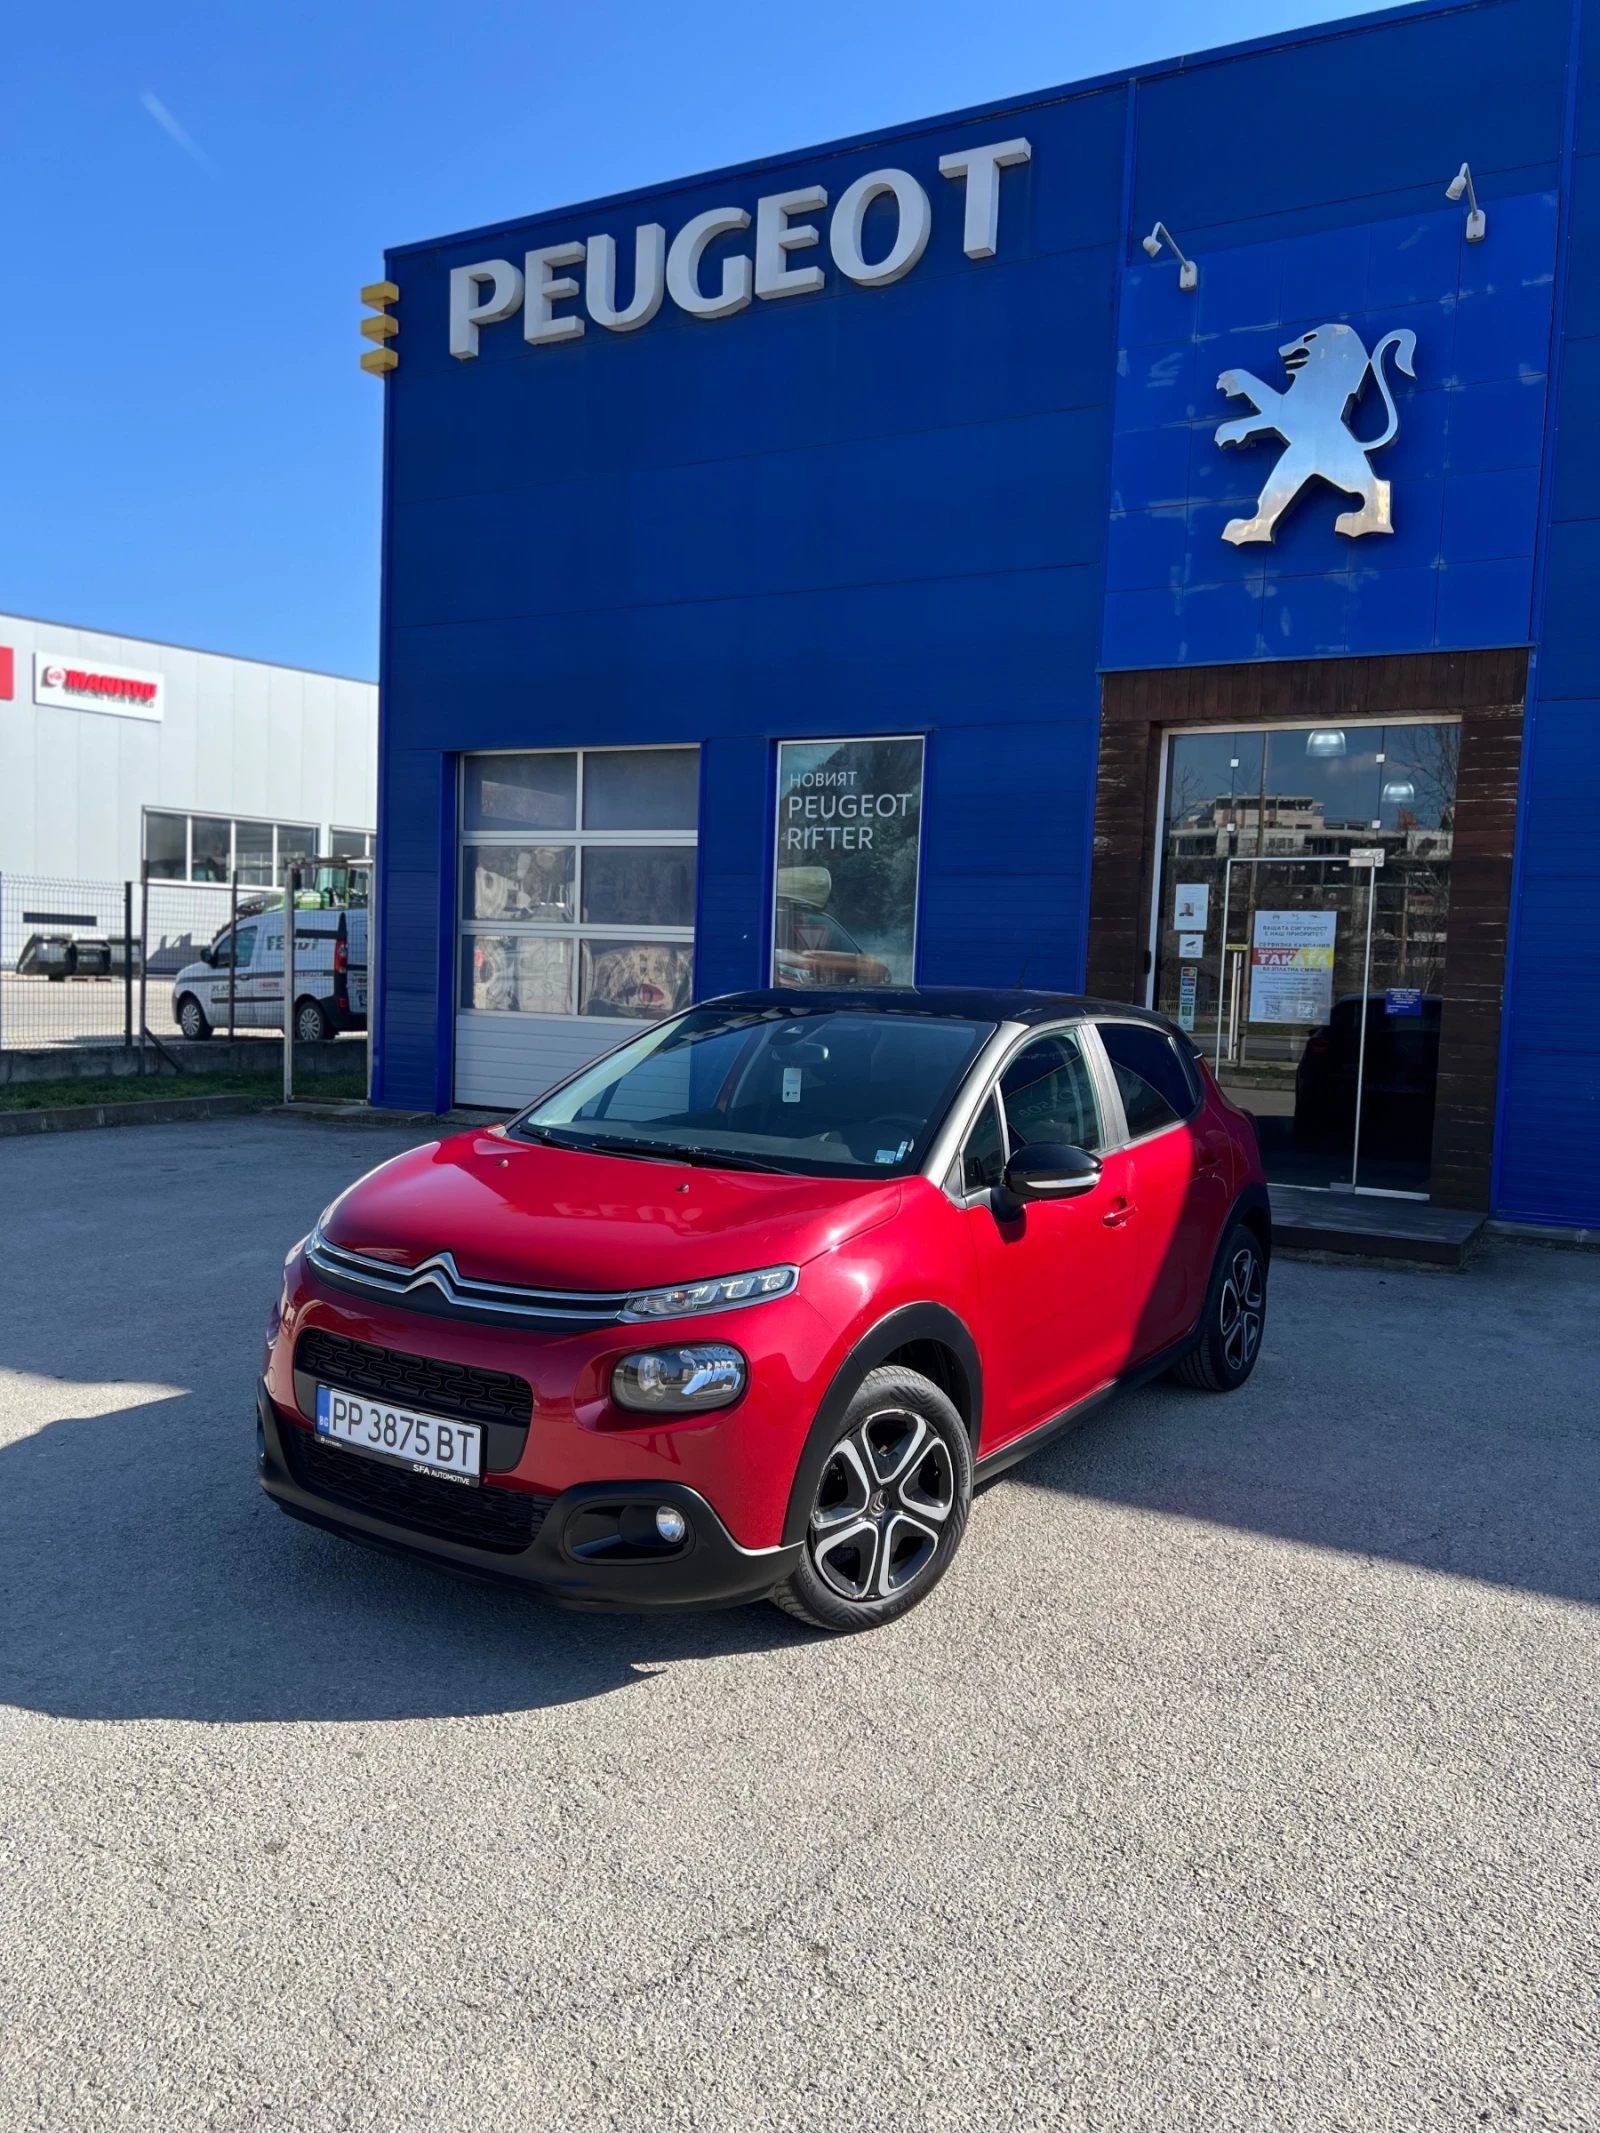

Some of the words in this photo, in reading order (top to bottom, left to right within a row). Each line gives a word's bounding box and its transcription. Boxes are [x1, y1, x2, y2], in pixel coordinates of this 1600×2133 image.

[449, 137, 1032, 360] PEUGEOT
[65, 669, 158, 699] MANITOU
[790, 771, 857, 788] НОВИЯТ
[788, 793, 913, 819] PEUGEOT
[787, 826, 873, 850] RIFTER
[267, 935, 319, 950] FEDT
[1258, 954, 1328, 965] TAKATA
[319, 1415, 329, 1427] BG
[333, 1398, 363, 1435] PP
[368, 1409, 430, 1456] 3875
[436, 1425, 475, 1466] BT
[413, 1464, 430, 1475] SFA
[431, 1469, 470, 1485] AUTOMOTIVE
